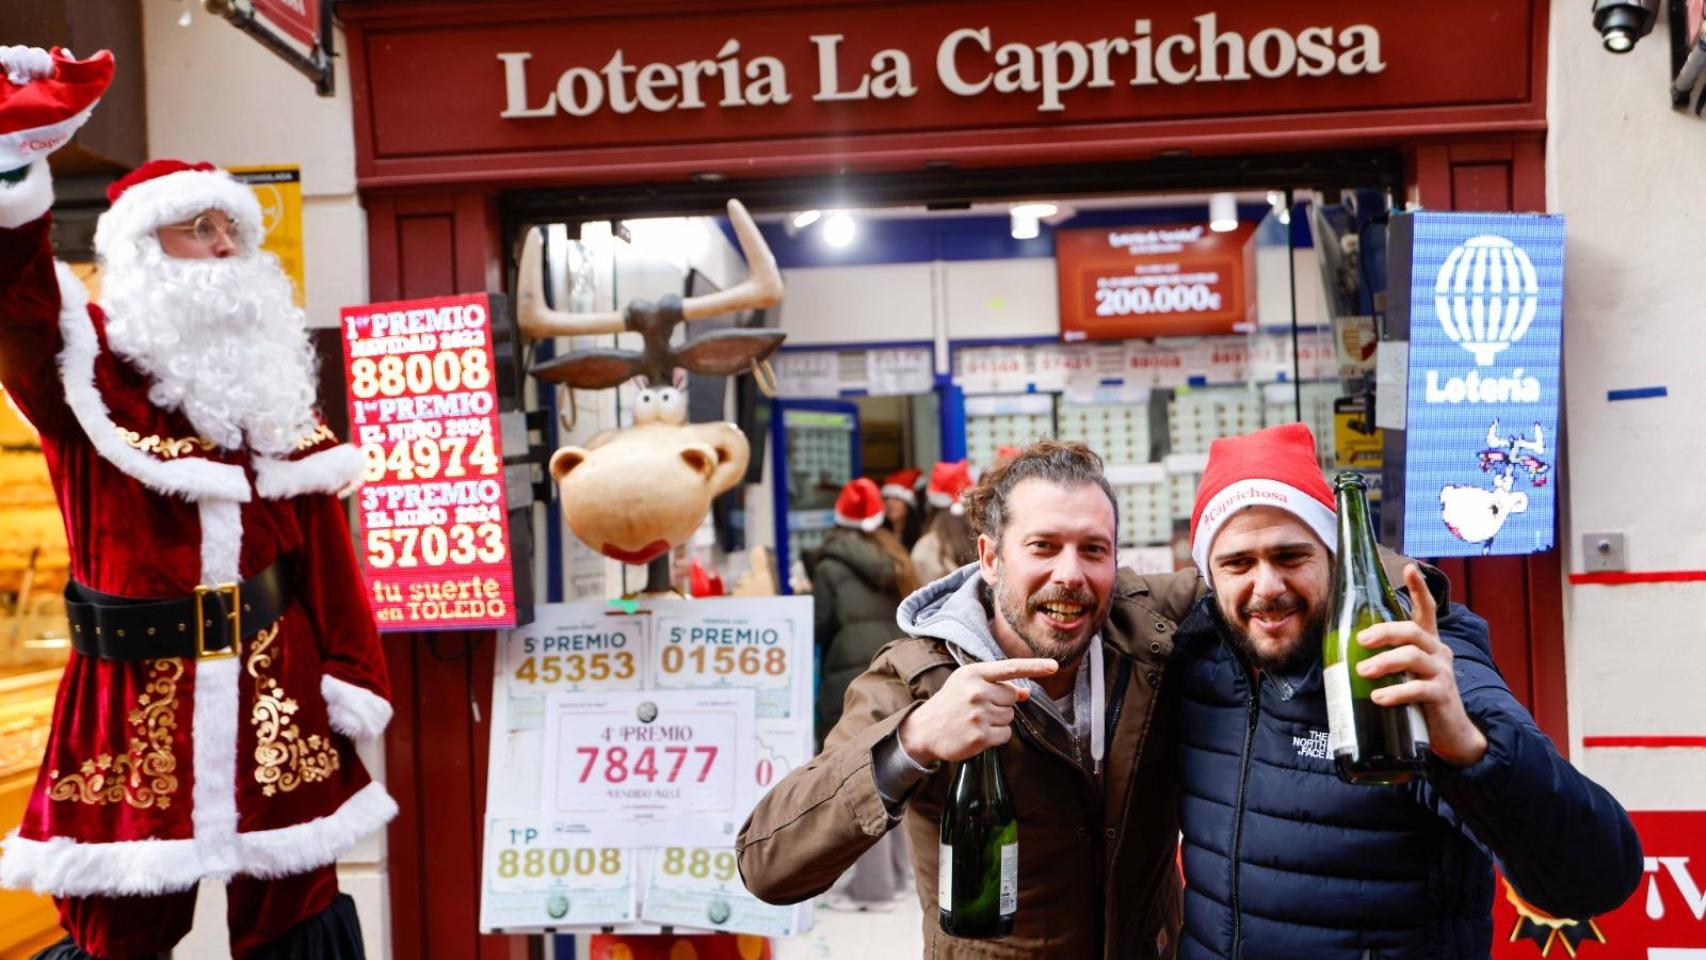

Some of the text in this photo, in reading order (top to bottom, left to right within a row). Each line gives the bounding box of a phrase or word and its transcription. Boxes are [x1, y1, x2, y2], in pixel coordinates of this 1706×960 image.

[497, 12, 1388, 118] Lotería La Caprichosa
[370, 304, 486, 338] PREMIO
[352, 347, 491, 399] 88008
[1425, 367, 1542, 404] Lotería
[379, 391, 494, 422] PREMIO
[359, 425, 386, 444] EL
[387, 419, 443, 443] NIÑO
[362, 434, 500, 483] 94974
[387, 480, 501, 509] PREMIO
[1209, 487, 1288, 522] Caprichosa
[365, 511, 394, 529] EL
[394, 505, 449, 527] NIÑO
[367, 523, 507, 569] 57033
[373, 576, 501, 603] tu suerte
[376, 600, 506, 621] en TOLEDO
[543, 632, 627, 652] PREMIO
[690, 628, 779, 645] PREMIO
[515, 651, 635, 684] 45353
[661, 645, 786, 676] 01568
[620, 725, 693, 742] PREMIO
[1292, 736, 1328, 751] NORTH
[1309, 730, 1328, 741] THE
[576, 746, 719, 784] 78477
[1299, 748, 1325, 759] FACE
[497, 847, 622, 879] 88008
